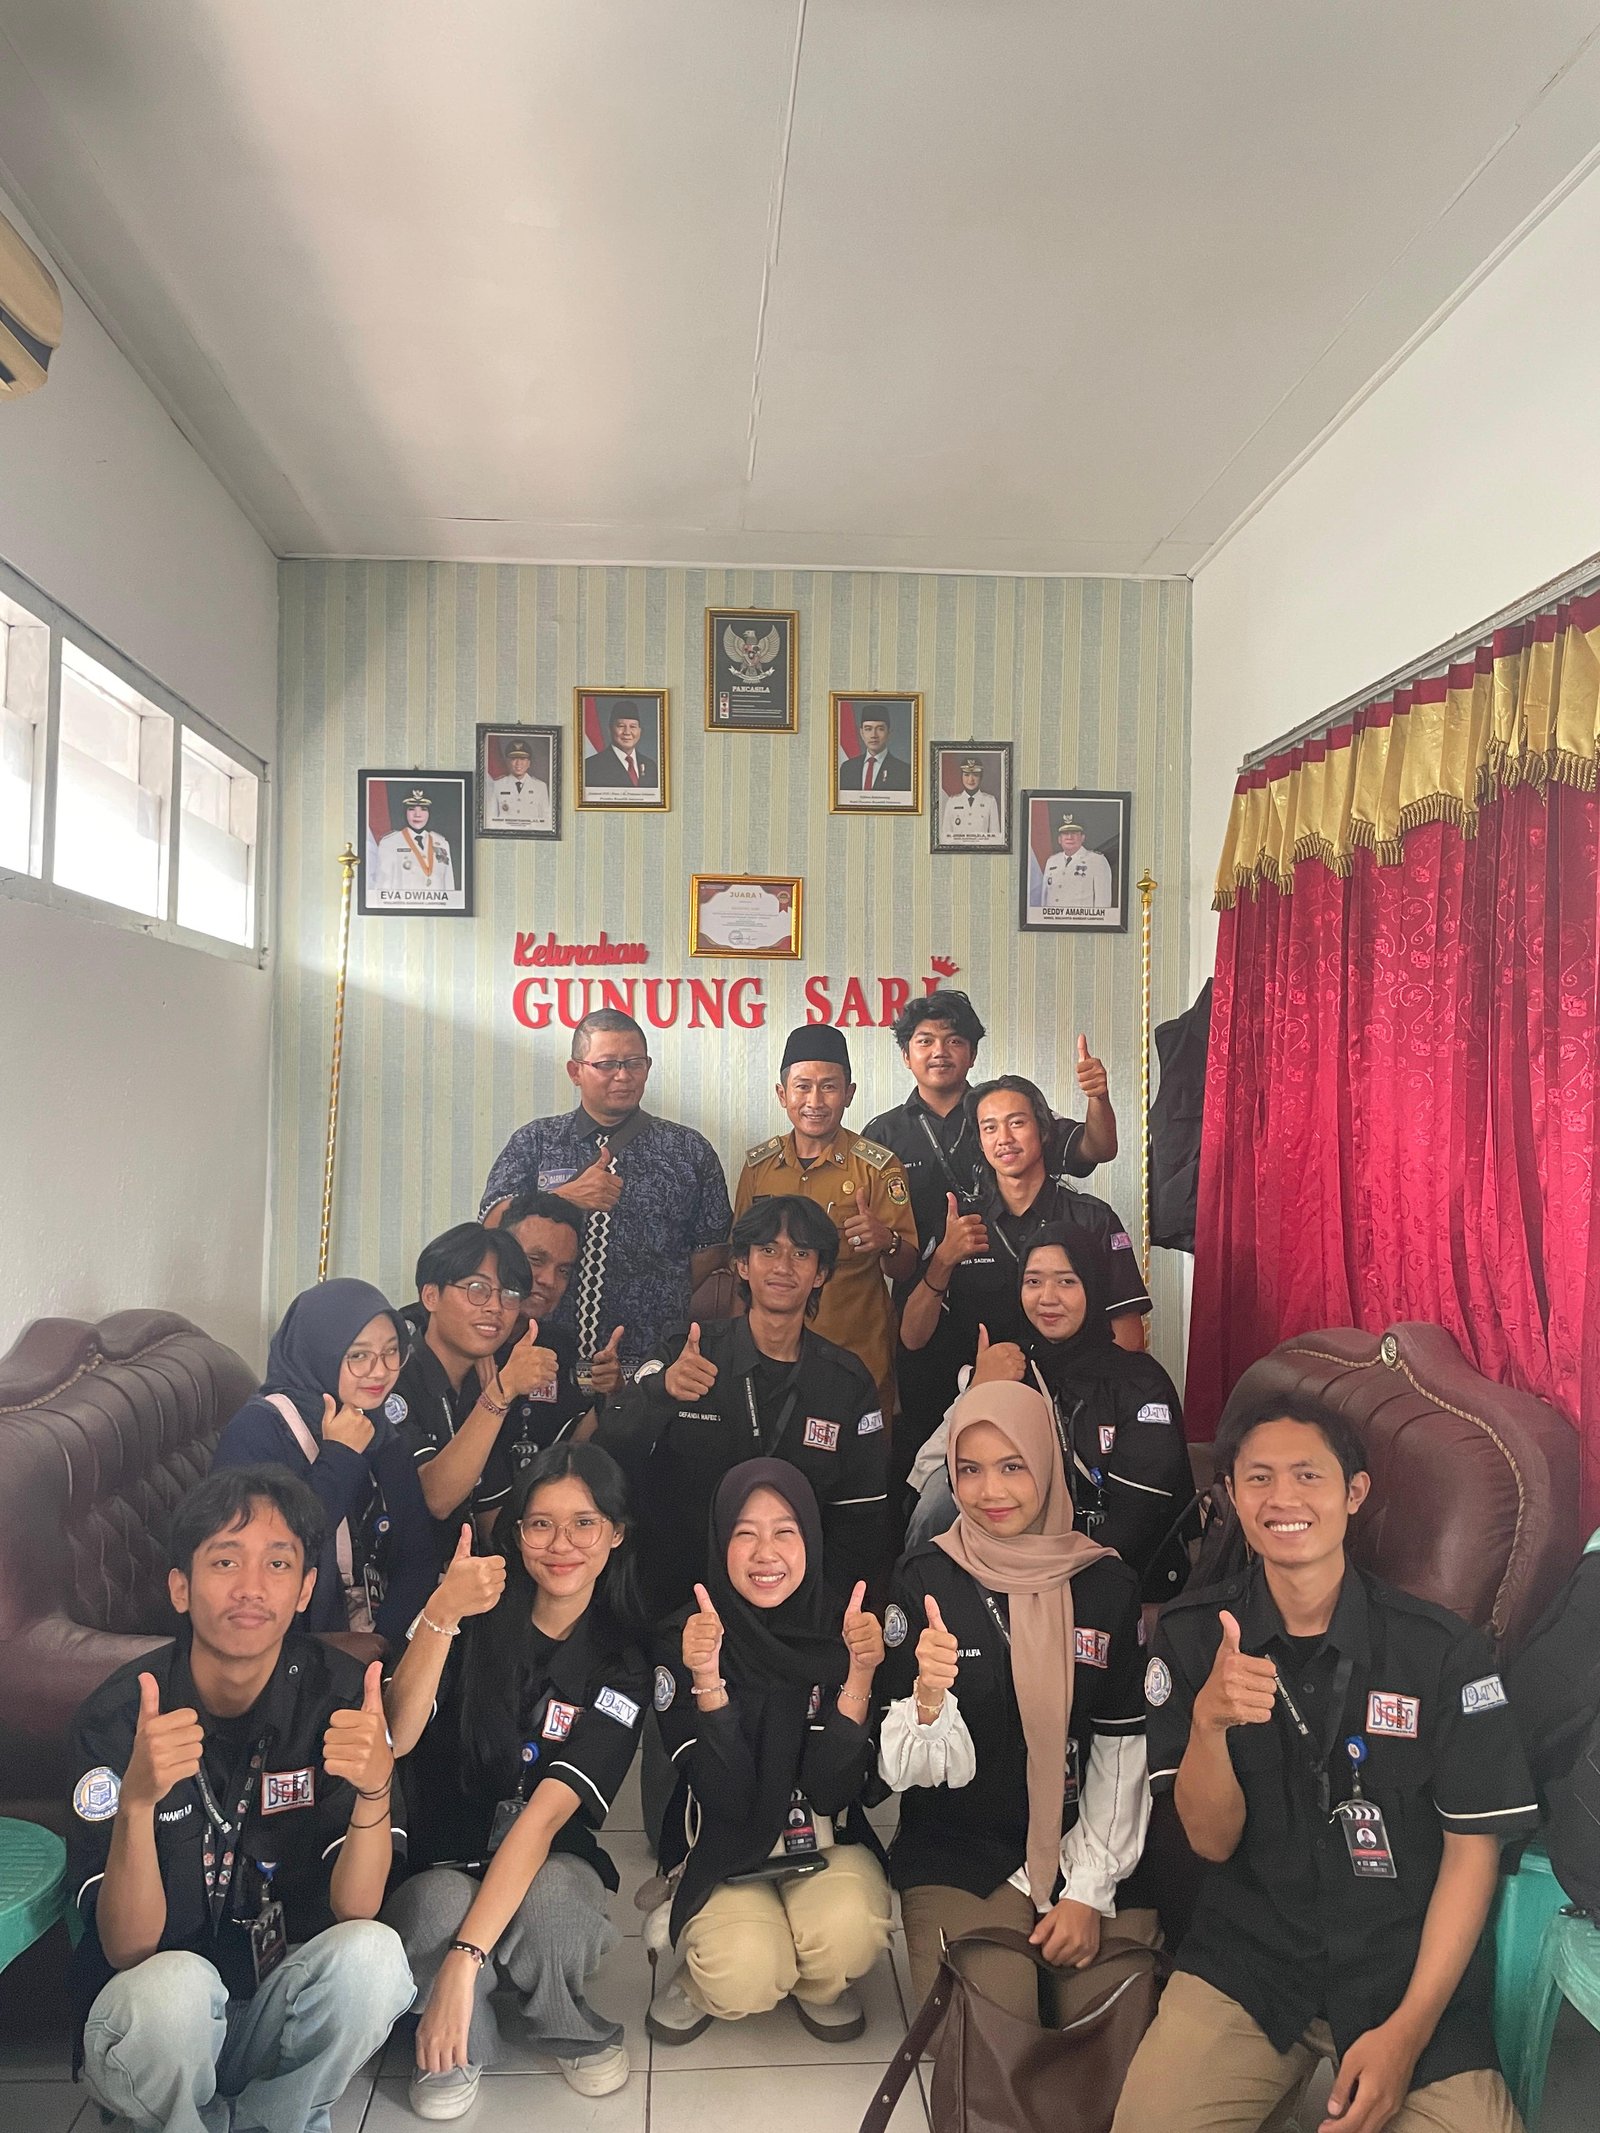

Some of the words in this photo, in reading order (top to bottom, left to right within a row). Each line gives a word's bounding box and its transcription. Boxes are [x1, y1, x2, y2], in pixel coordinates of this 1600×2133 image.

[732, 685, 770, 693] PANCASILA
[380, 891, 401, 900] EVA
[405, 891, 448, 900] DWIANA
[729, 891, 757, 899] JUARA
[1065, 908, 1105, 916] AMARULLAH
[512, 977, 767, 1029] GUNUNG
